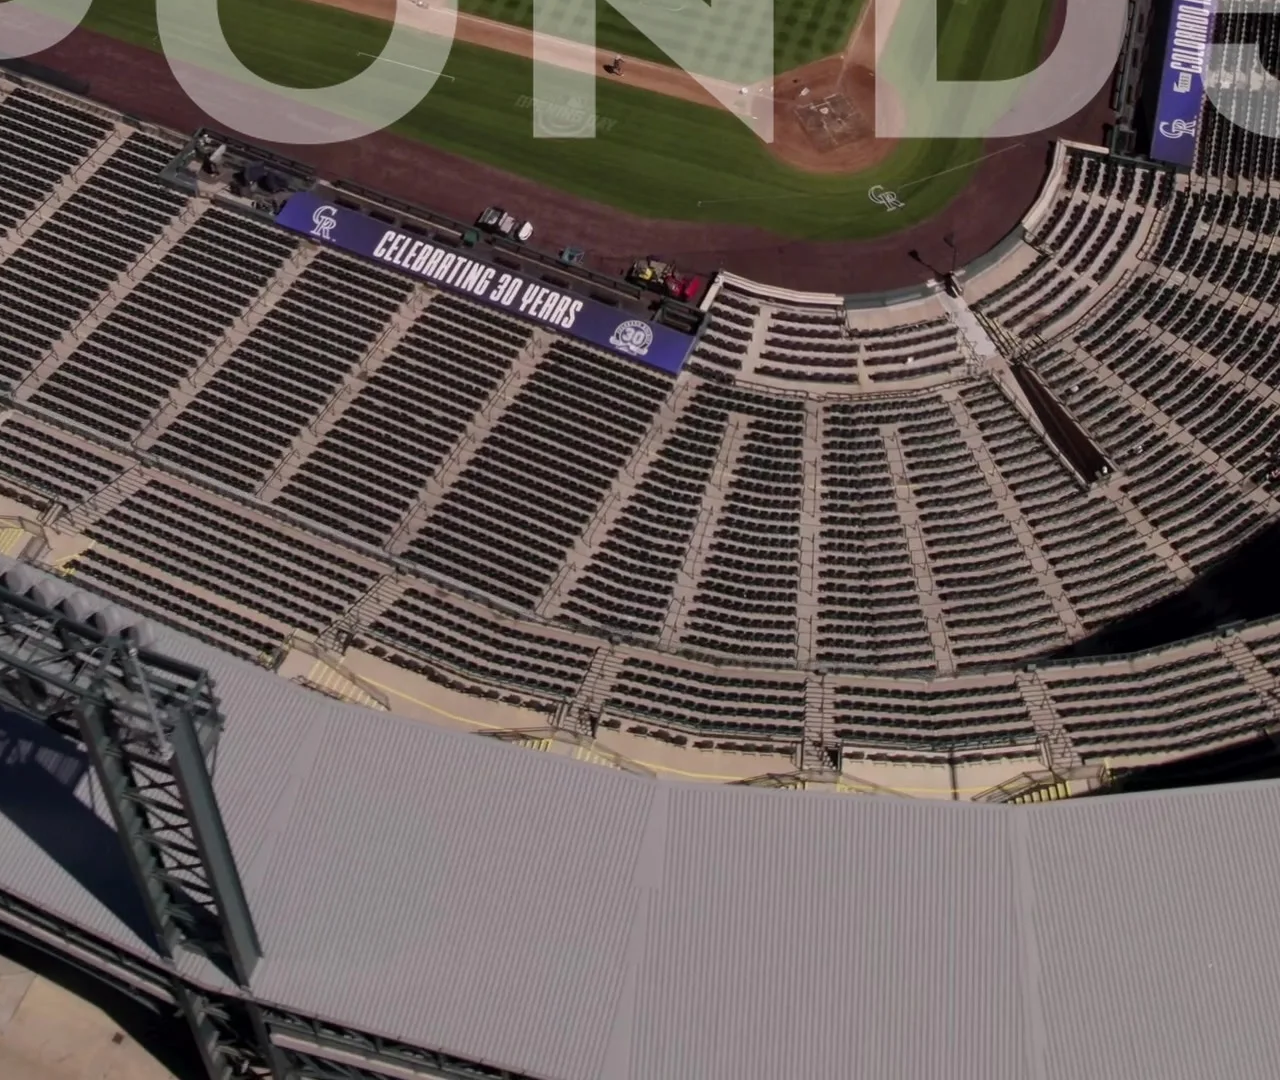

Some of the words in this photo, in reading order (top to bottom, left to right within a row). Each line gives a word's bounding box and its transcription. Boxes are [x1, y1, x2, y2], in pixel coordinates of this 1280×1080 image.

[1170, 5, 1210, 74] COLORADO
[373, 230, 496, 296] CELEBRATING
[489, 273, 523, 306] 30
[520, 283, 583, 329] YEARS
[622, 327, 646, 347] 30
